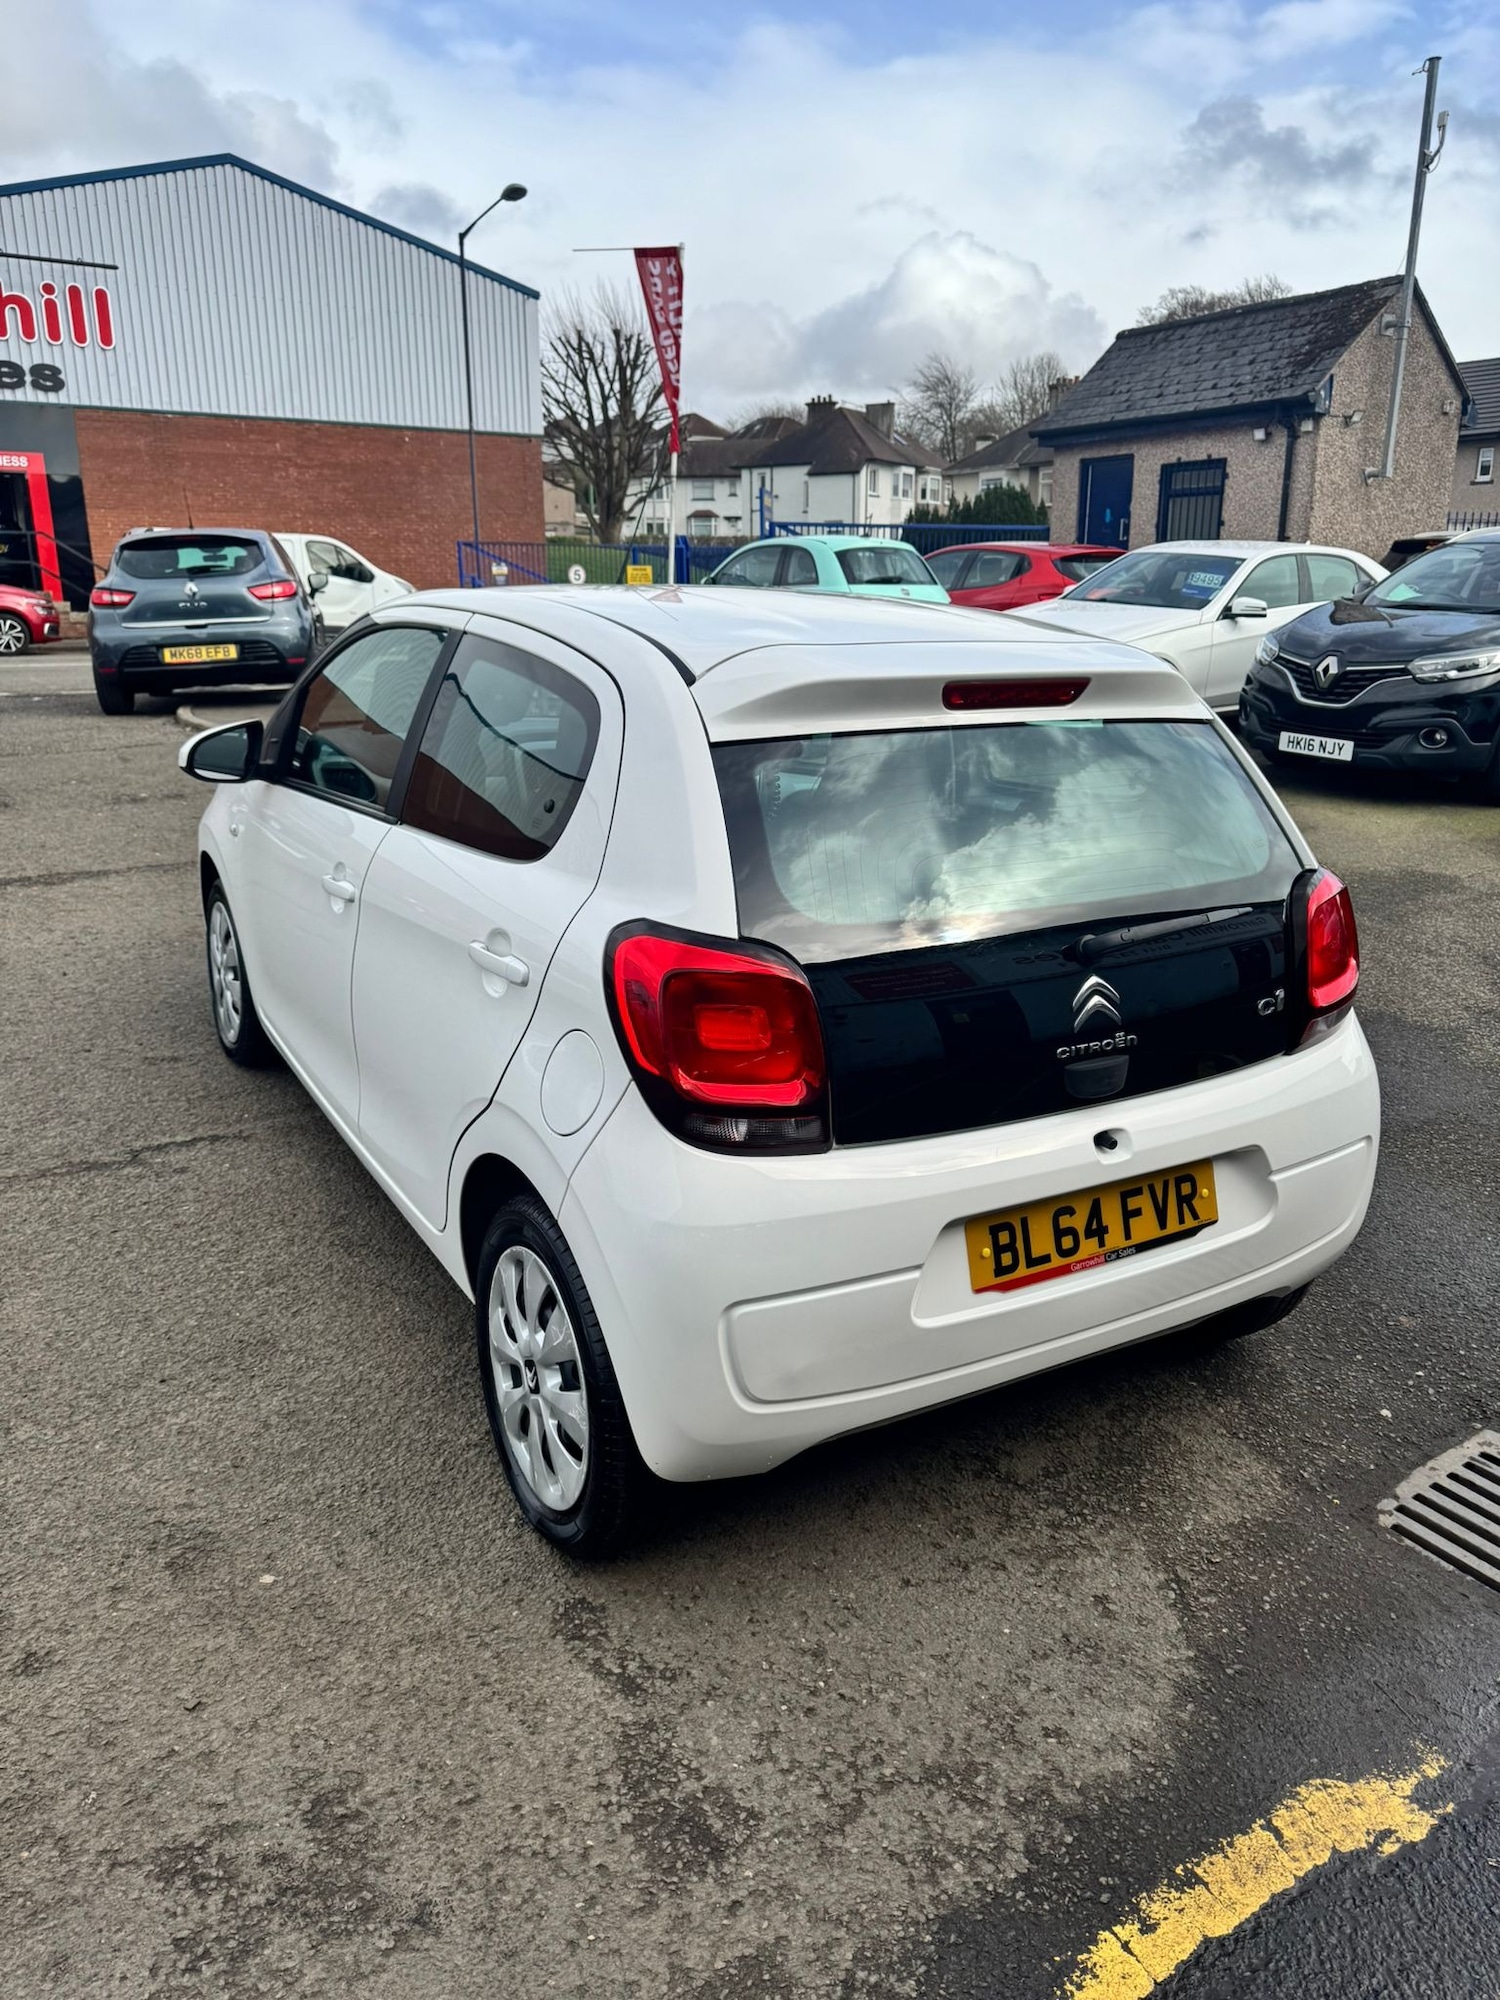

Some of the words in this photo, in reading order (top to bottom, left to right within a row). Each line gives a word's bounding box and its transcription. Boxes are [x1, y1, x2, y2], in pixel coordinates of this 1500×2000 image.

[0, 455, 28, 467] ESS
[573, 569, 582, 582] 5
[1287, 735, 1315, 752] HK16
[1318, 740, 1345, 756] NJY
[1257, 988, 1284, 1016] C1
[988, 1197, 1109, 1278] BL64
[1119, 1173, 1200, 1241] FVR
[1070, 1254, 1105, 1272] Garrowhill
[1105, 1251, 1118, 1262] Car
[1118, 1247, 1136, 1258] Sales
